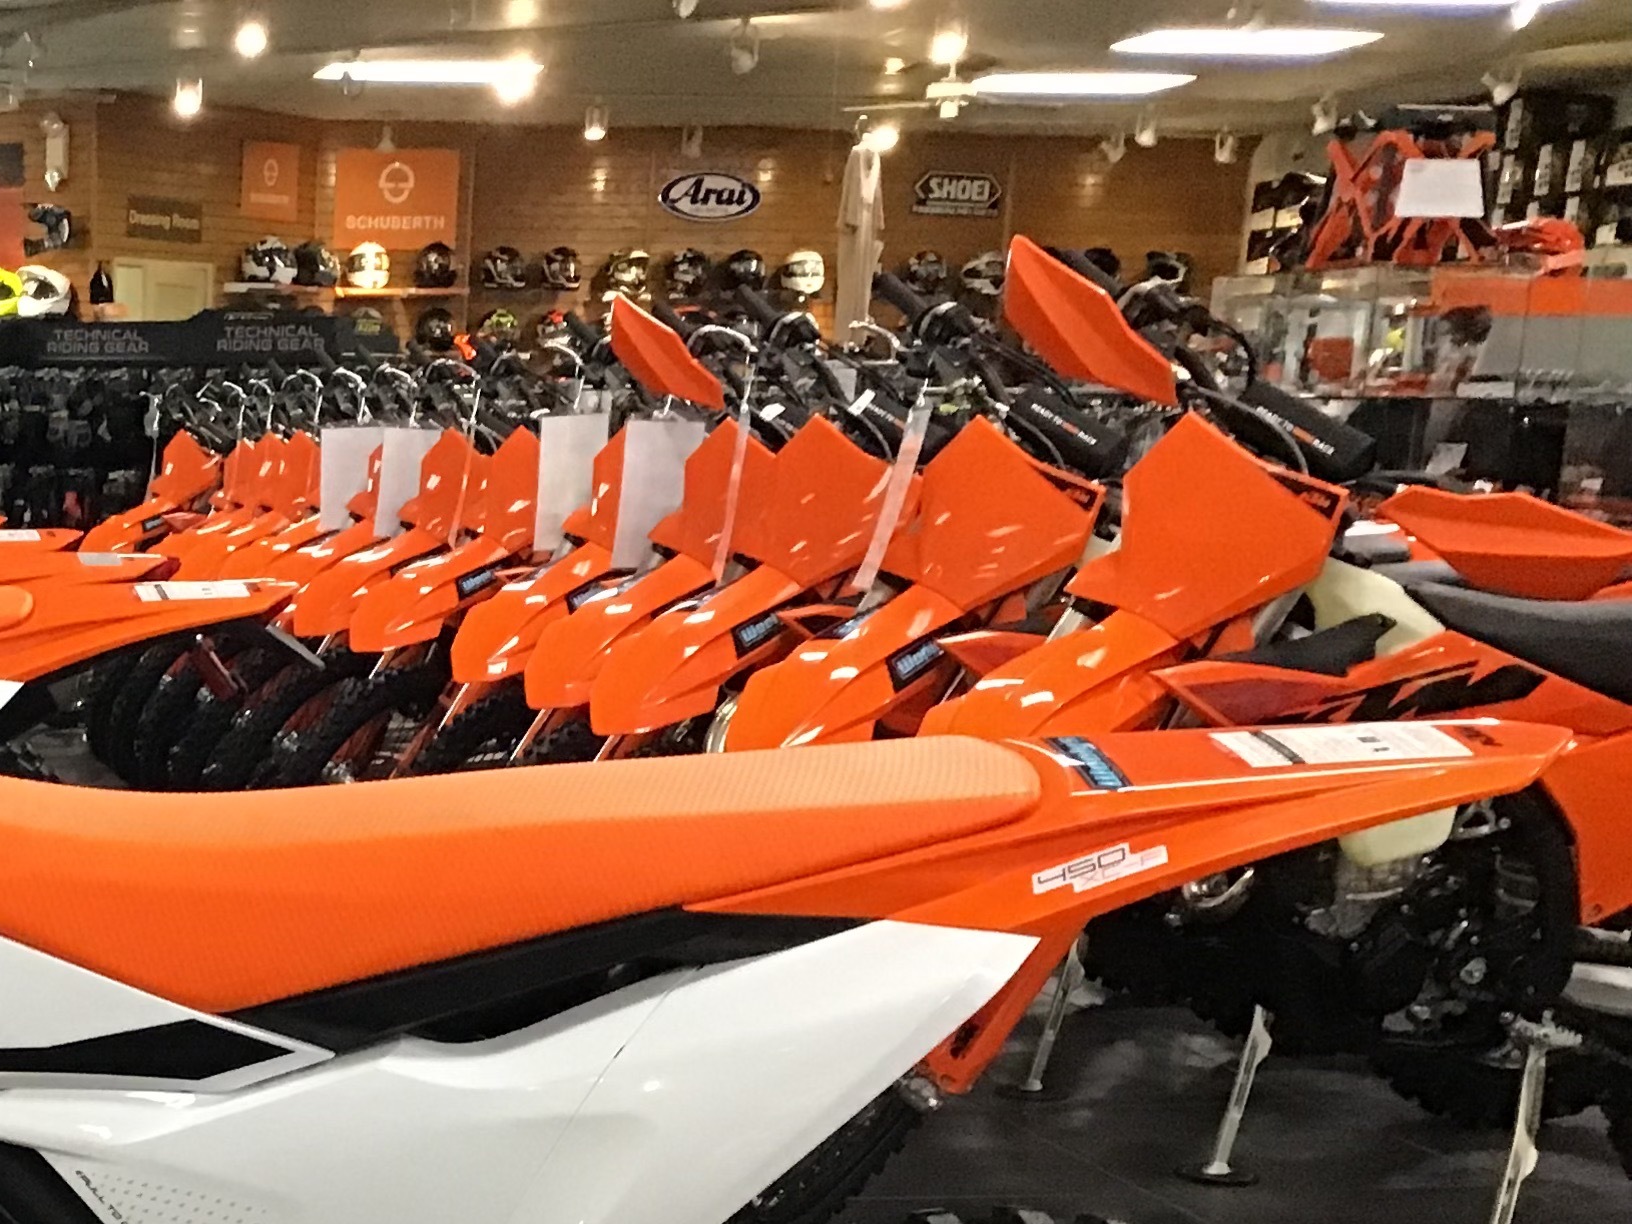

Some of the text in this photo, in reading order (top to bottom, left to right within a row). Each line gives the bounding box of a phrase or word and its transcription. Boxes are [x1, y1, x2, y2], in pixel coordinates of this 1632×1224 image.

[668, 176, 746, 206] Arai
[928, 177, 990, 202] SHOEI
[346, 214, 446, 230] SCHUBERTH
[53, 329, 144, 341] TECHNICAL
[223, 325, 320, 338] TECHNICAL
[47, 341, 150, 354] RIDING GEAR
[216, 337, 326, 352] RIDING GEAR
[1037, 848, 1126, 885] 450
